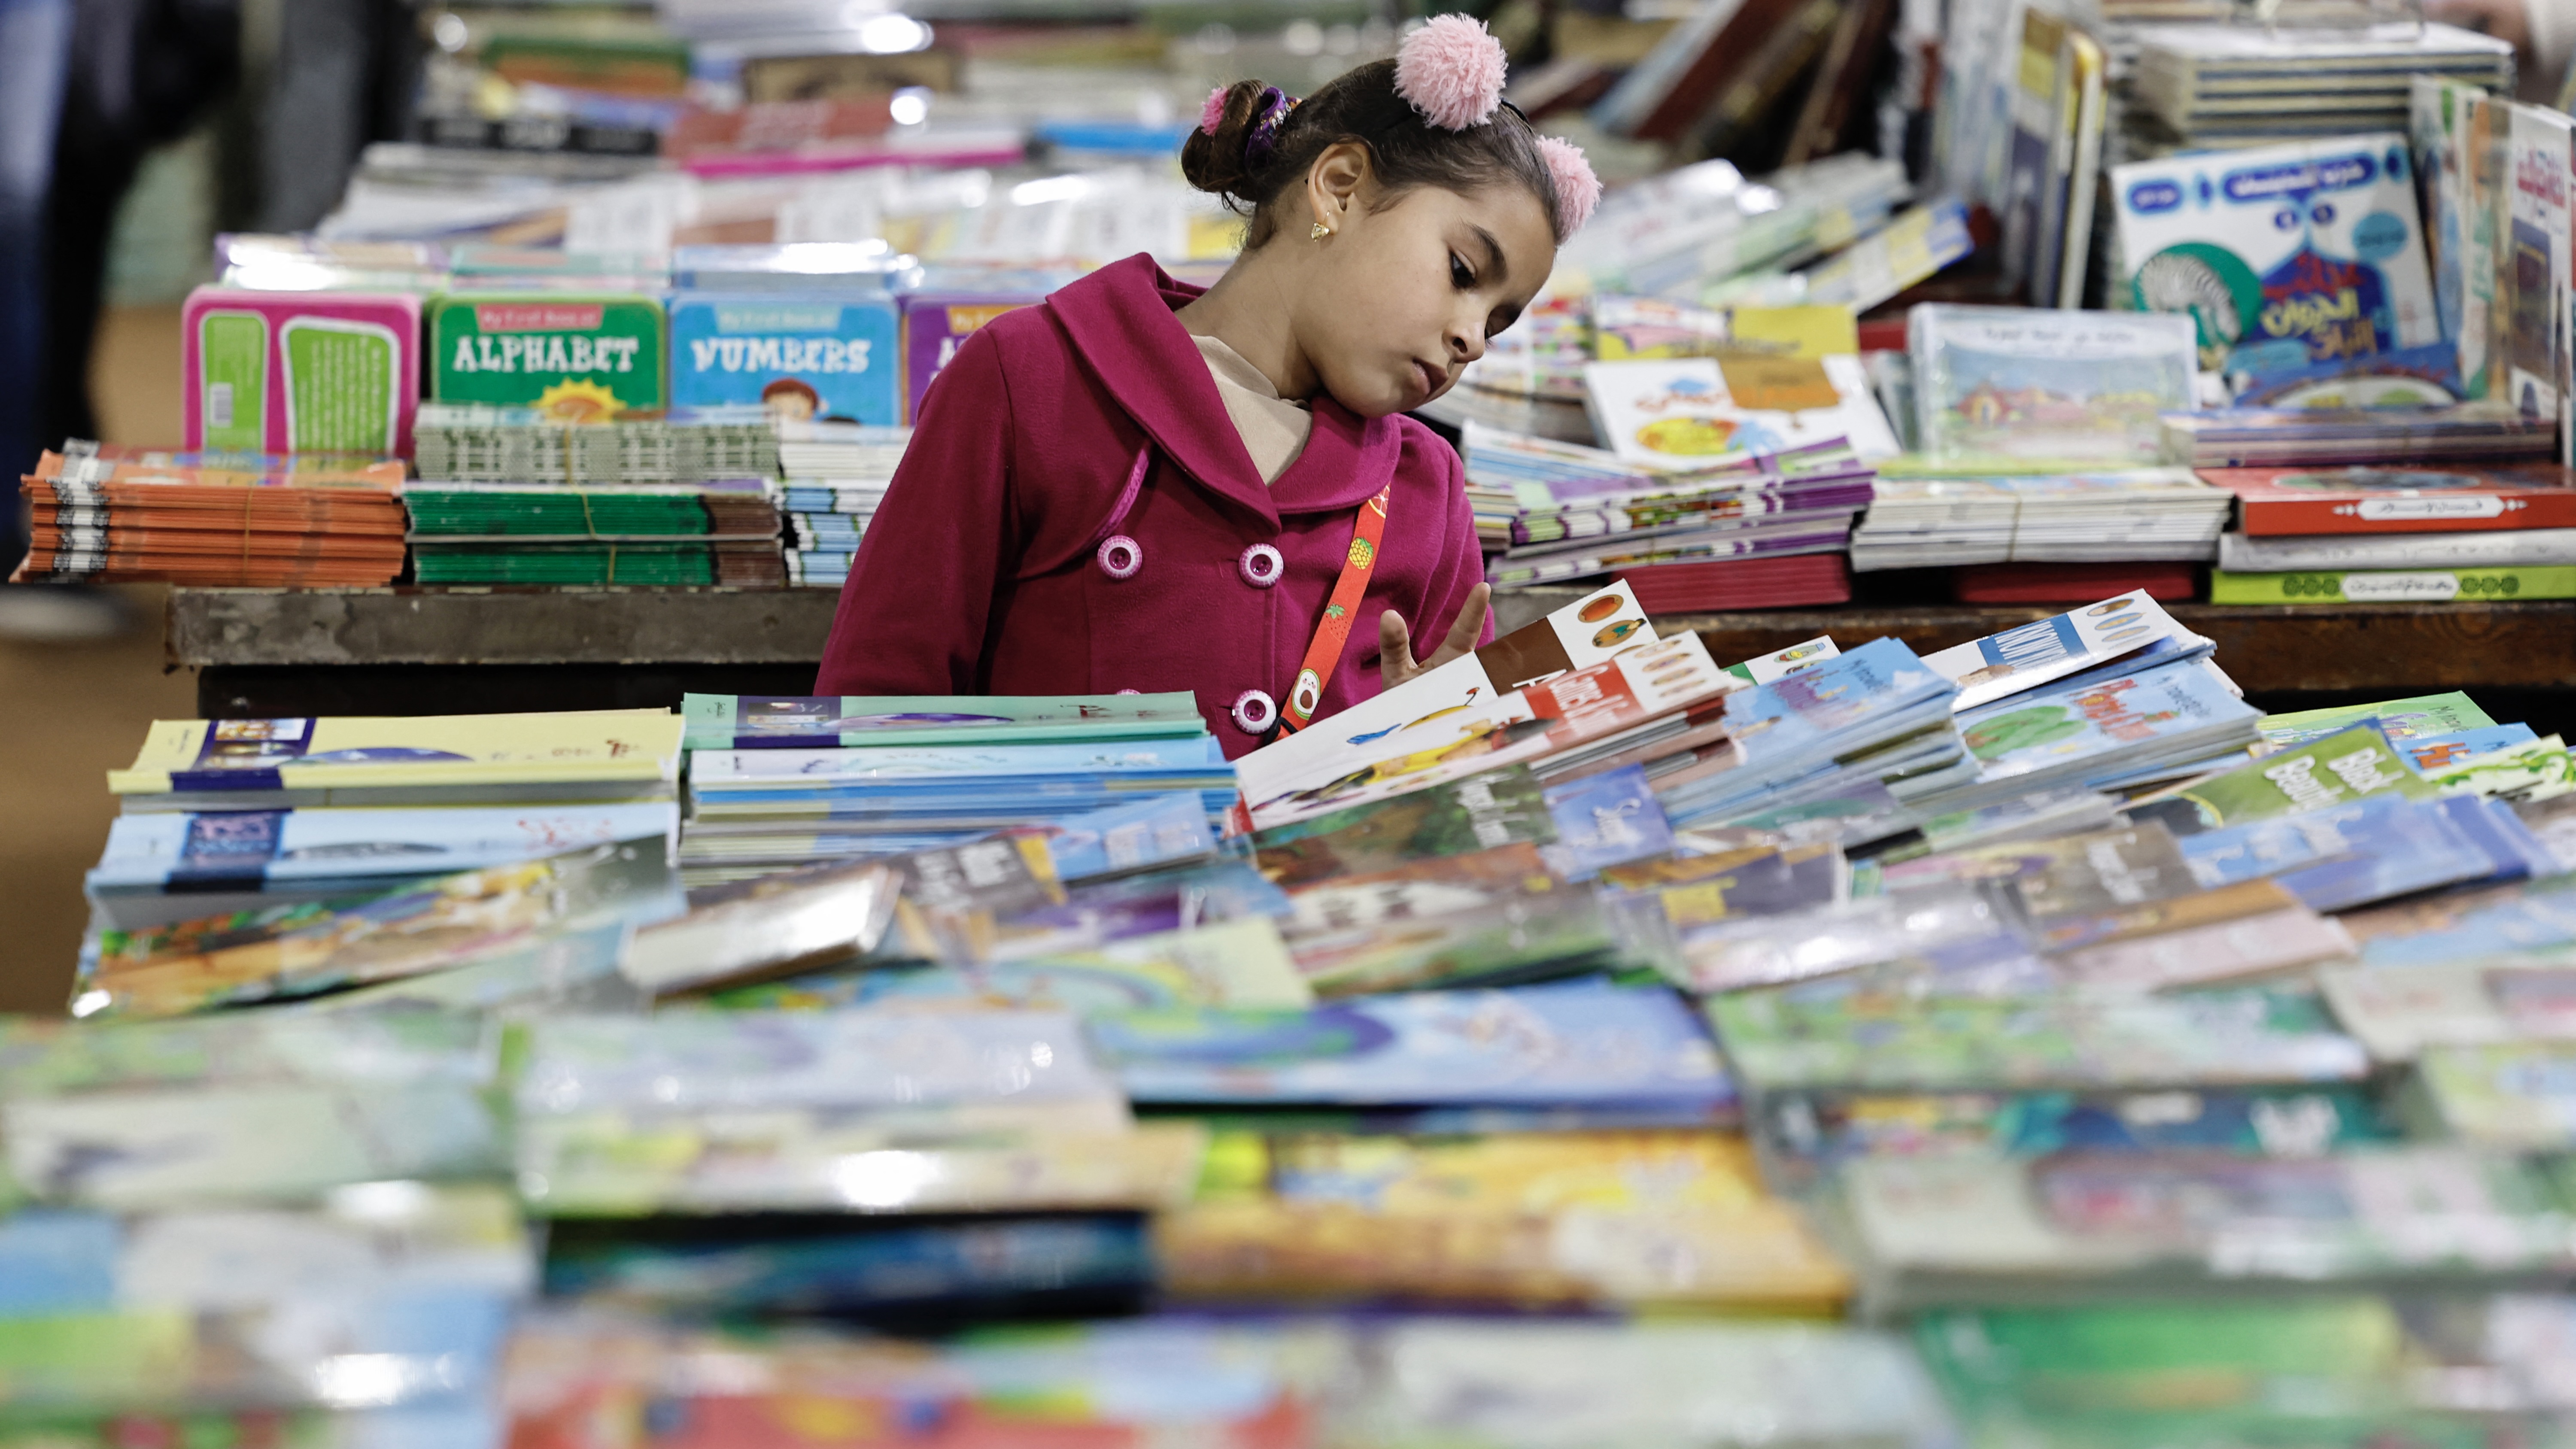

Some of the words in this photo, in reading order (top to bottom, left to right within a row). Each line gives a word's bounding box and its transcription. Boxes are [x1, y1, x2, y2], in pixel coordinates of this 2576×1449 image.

[2260, 286, 2360, 338] الحيوان
[453, 335, 639, 373] ALPHABET
[690, 337, 872, 374] NUMBERS
[1994, 621, 2063, 660] KNOW
[1549, 665, 1609, 711] Games
[2327, 747, 2405, 794] Black
